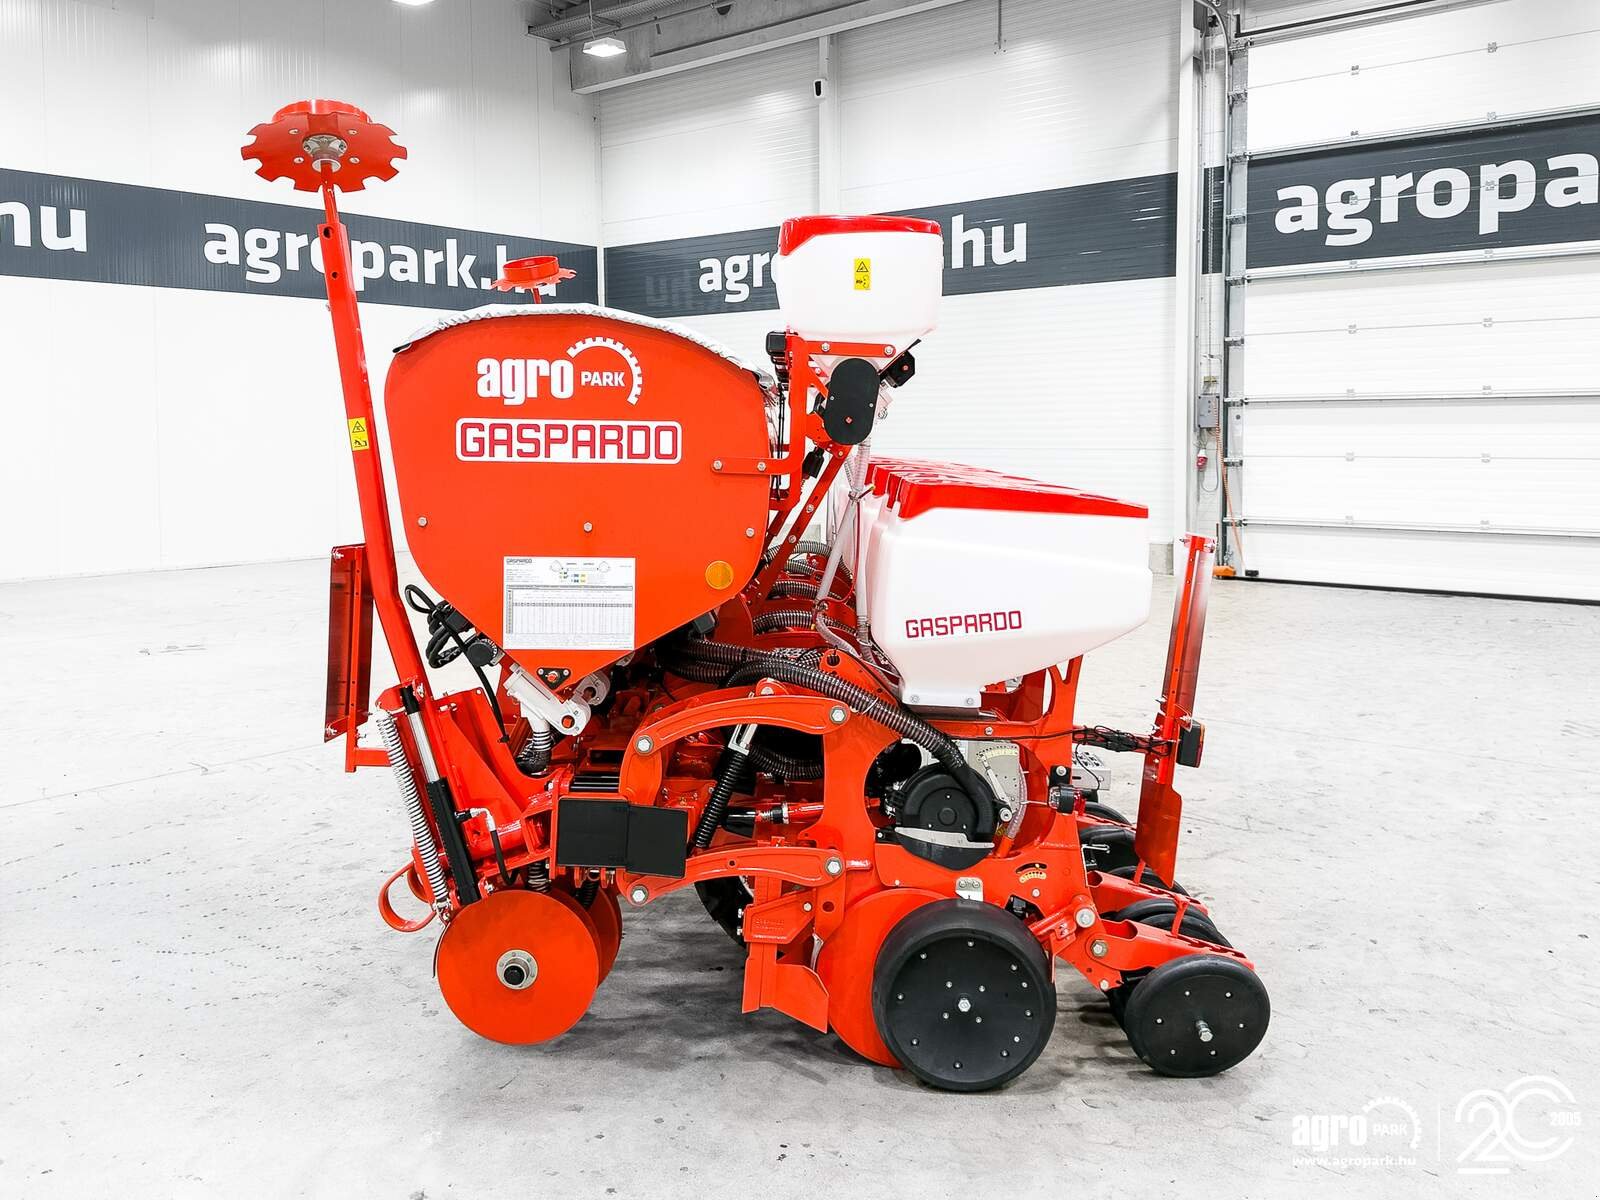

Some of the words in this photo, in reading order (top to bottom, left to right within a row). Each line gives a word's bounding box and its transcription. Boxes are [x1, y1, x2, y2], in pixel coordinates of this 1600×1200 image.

[1274, 153, 1599, 246] agropa
[698, 251, 780, 303] agr
[476, 357, 574, 406] agro
[580, 371, 625, 387] PARK
[460, 422, 678, 460] GASPARDO
[905, 610, 1022, 638] GASPARDO
